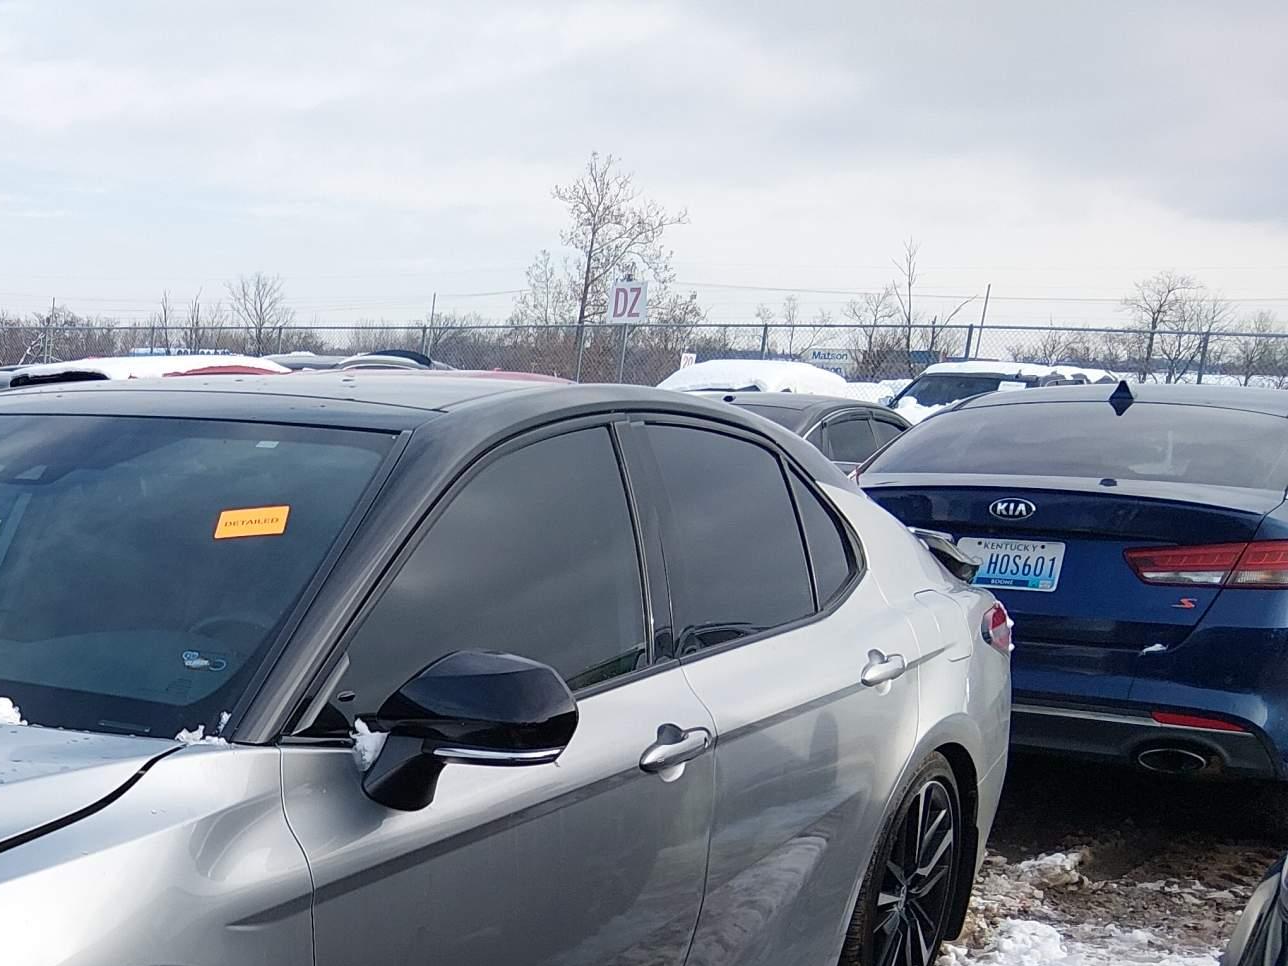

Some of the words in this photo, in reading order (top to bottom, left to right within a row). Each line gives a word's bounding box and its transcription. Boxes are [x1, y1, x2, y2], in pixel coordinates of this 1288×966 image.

[613, 287, 642, 317] DZ
[812, 351, 848, 360] Matson
[996, 502, 1027, 516] KIA
[224, 517, 279, 527] DETAILED
[984, 542, 1039, 552] KENTUCKY
